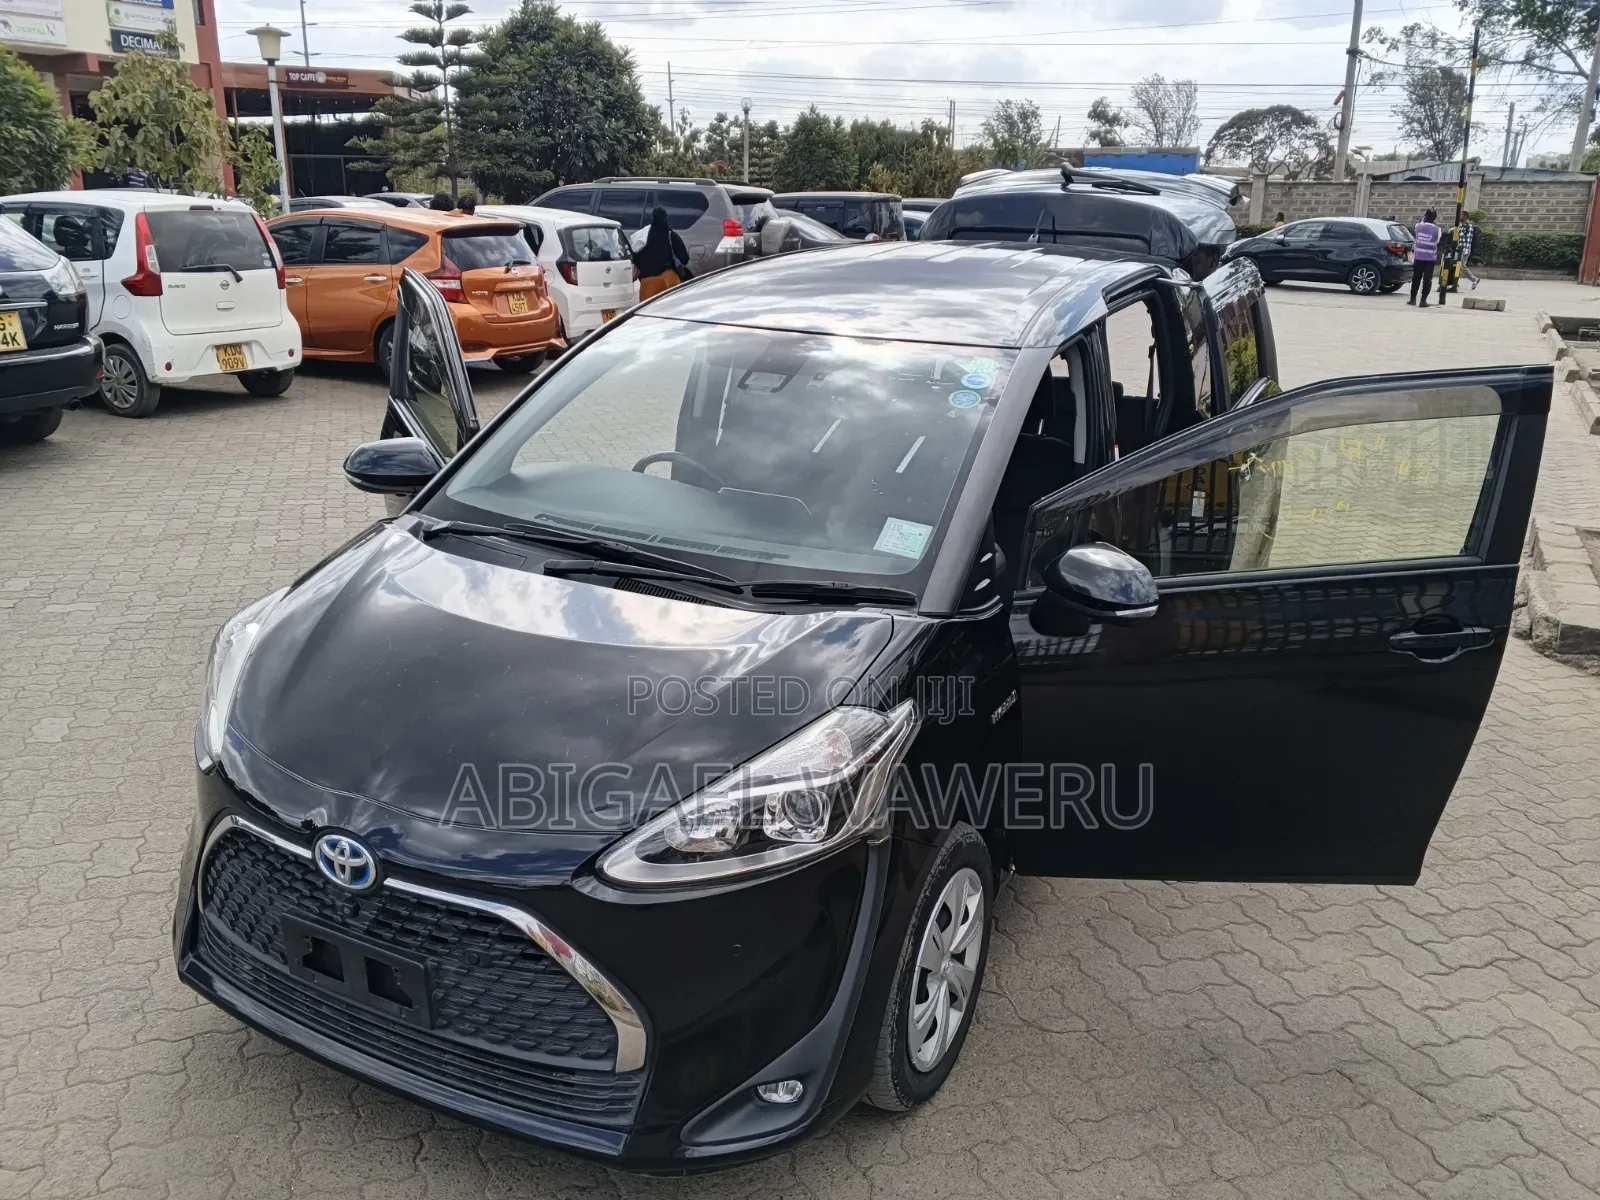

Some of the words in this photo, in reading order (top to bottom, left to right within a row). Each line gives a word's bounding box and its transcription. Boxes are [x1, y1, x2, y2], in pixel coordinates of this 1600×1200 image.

[120, 34, 165, 50] DECIMA
[289, 72, 300, 81] TOP
[221, 357, 245, 370] 909V
